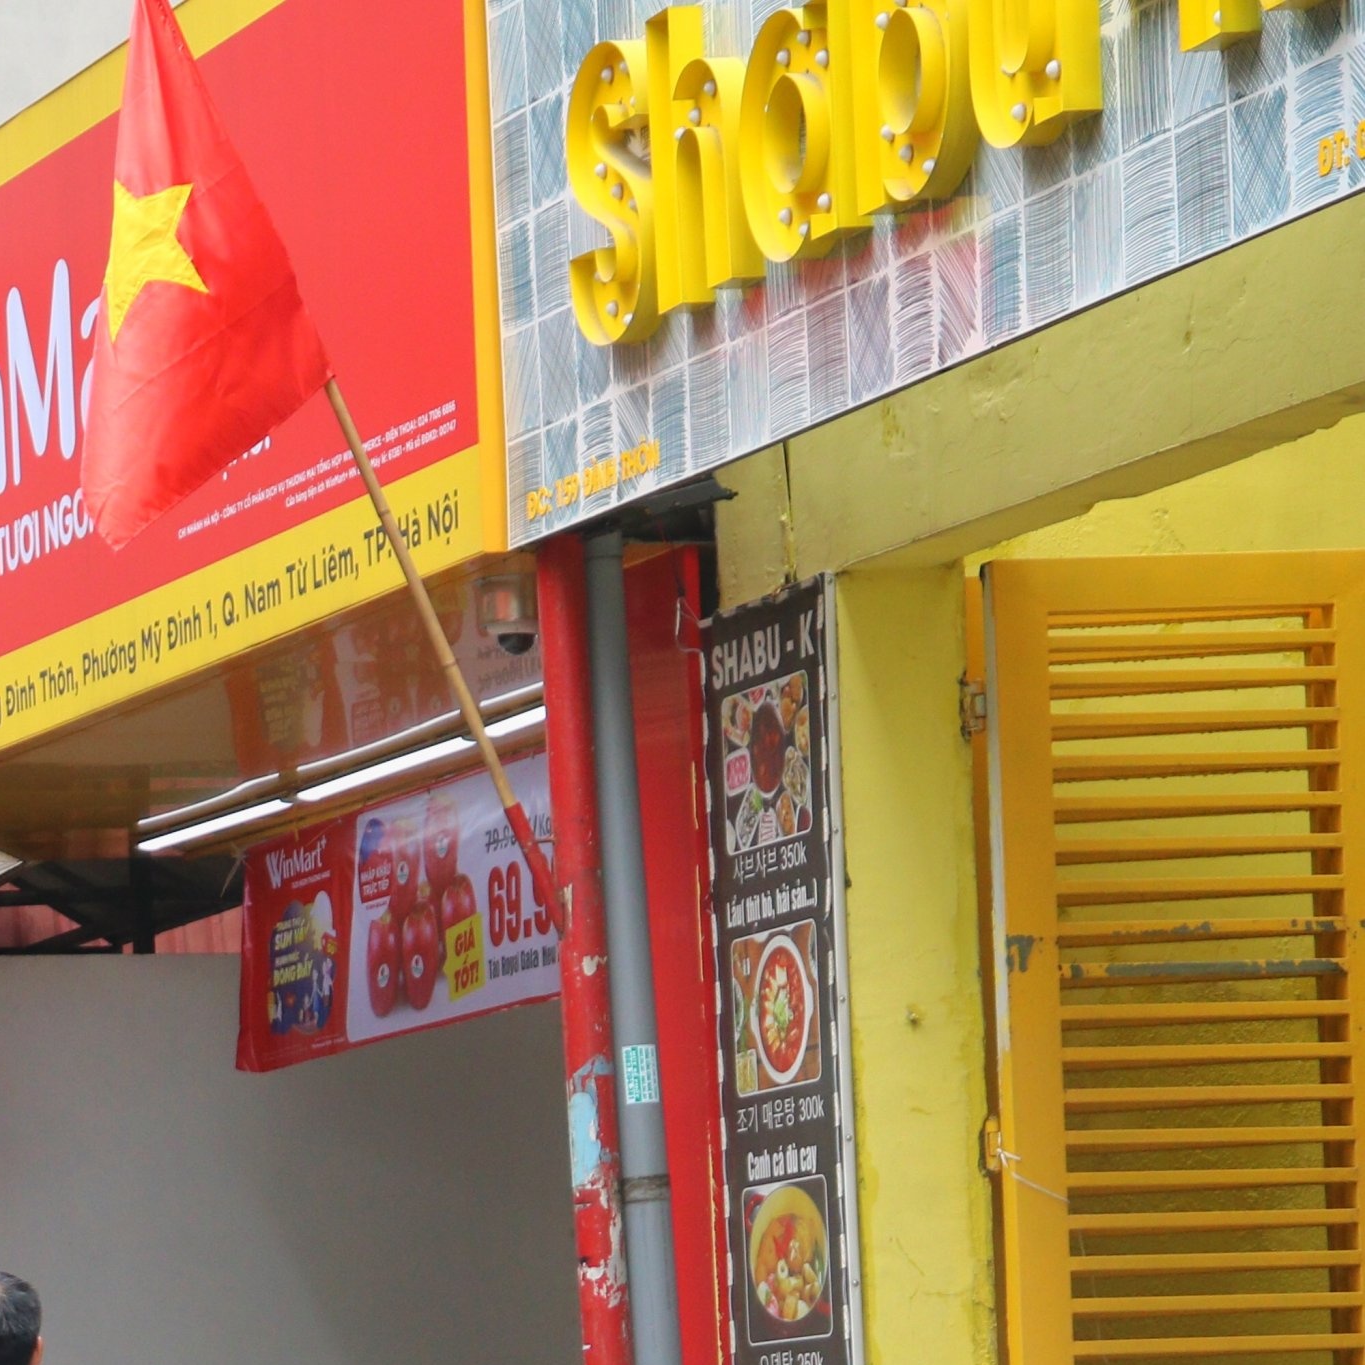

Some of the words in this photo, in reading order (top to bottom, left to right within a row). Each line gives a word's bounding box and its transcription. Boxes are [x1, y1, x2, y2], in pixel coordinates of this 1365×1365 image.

[526, 486, 553, 521] ĐC:
[554, 473, 580, 509] 159
[582, 455, 618, 497] ĐÌNH
[621, 435, 661, 482] THÔN
[43, 496, 94, 556] NGO
[5, 676, 37, 720] Đình
[39, 655, 80, 708] Thôn,
[82, 634, 137, 688] Phường
[140, 621, 162, 664] Mỹ
[166, 607, 203, 653] Đình
[222, 591, 241, 628] Q.
[244, 578, 282, 620] Nam
[285, 558, 308, 601] Từ
[312, 546, 360, 593] Liêm,
[364, 526, 392, 568] TP.
[427, 494, 460, 547] Nội
[712, 624, 781, 692] SHABU
[780, 841, 808, 870] 350k
[799, 1092, 825, 1122] 300k
[747, 1149, 771, 1182] Canh
[773, 1145, 785, 1178] cá
[800, 1143, 818, 1175] cay
